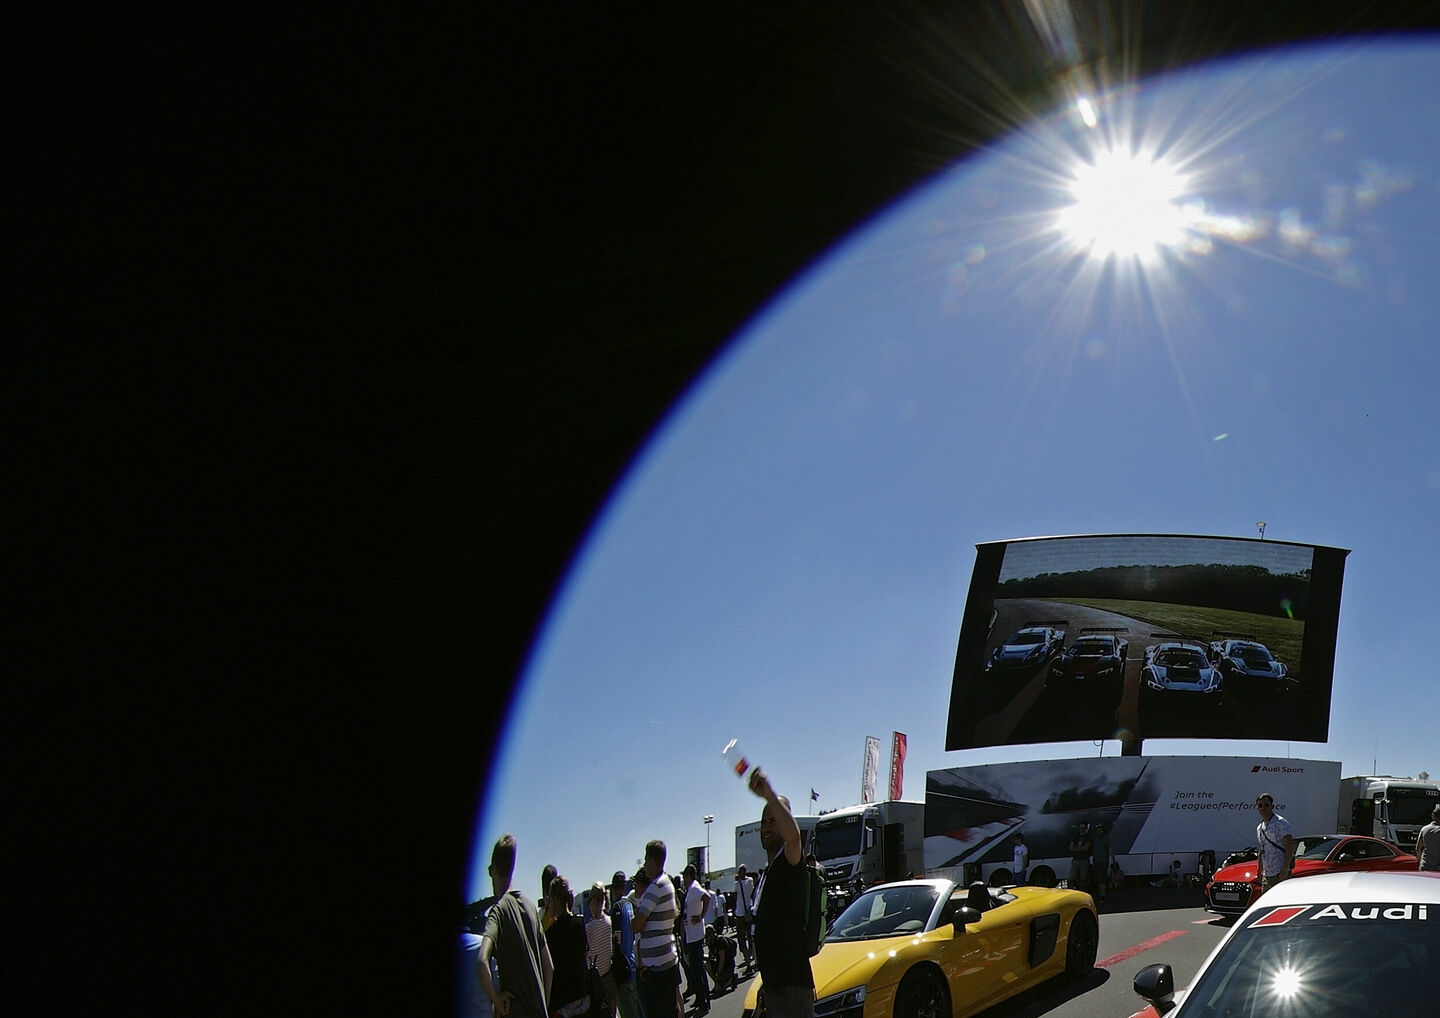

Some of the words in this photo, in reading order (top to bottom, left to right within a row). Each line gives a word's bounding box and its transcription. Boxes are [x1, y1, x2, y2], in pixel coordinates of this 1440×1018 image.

[1282, 766, 1304, 774] Sport
[1175, 791, 1194, 799] Join
[1197, 791, 1214, 799] the
[1309, 904, 1427, 921] Audi
